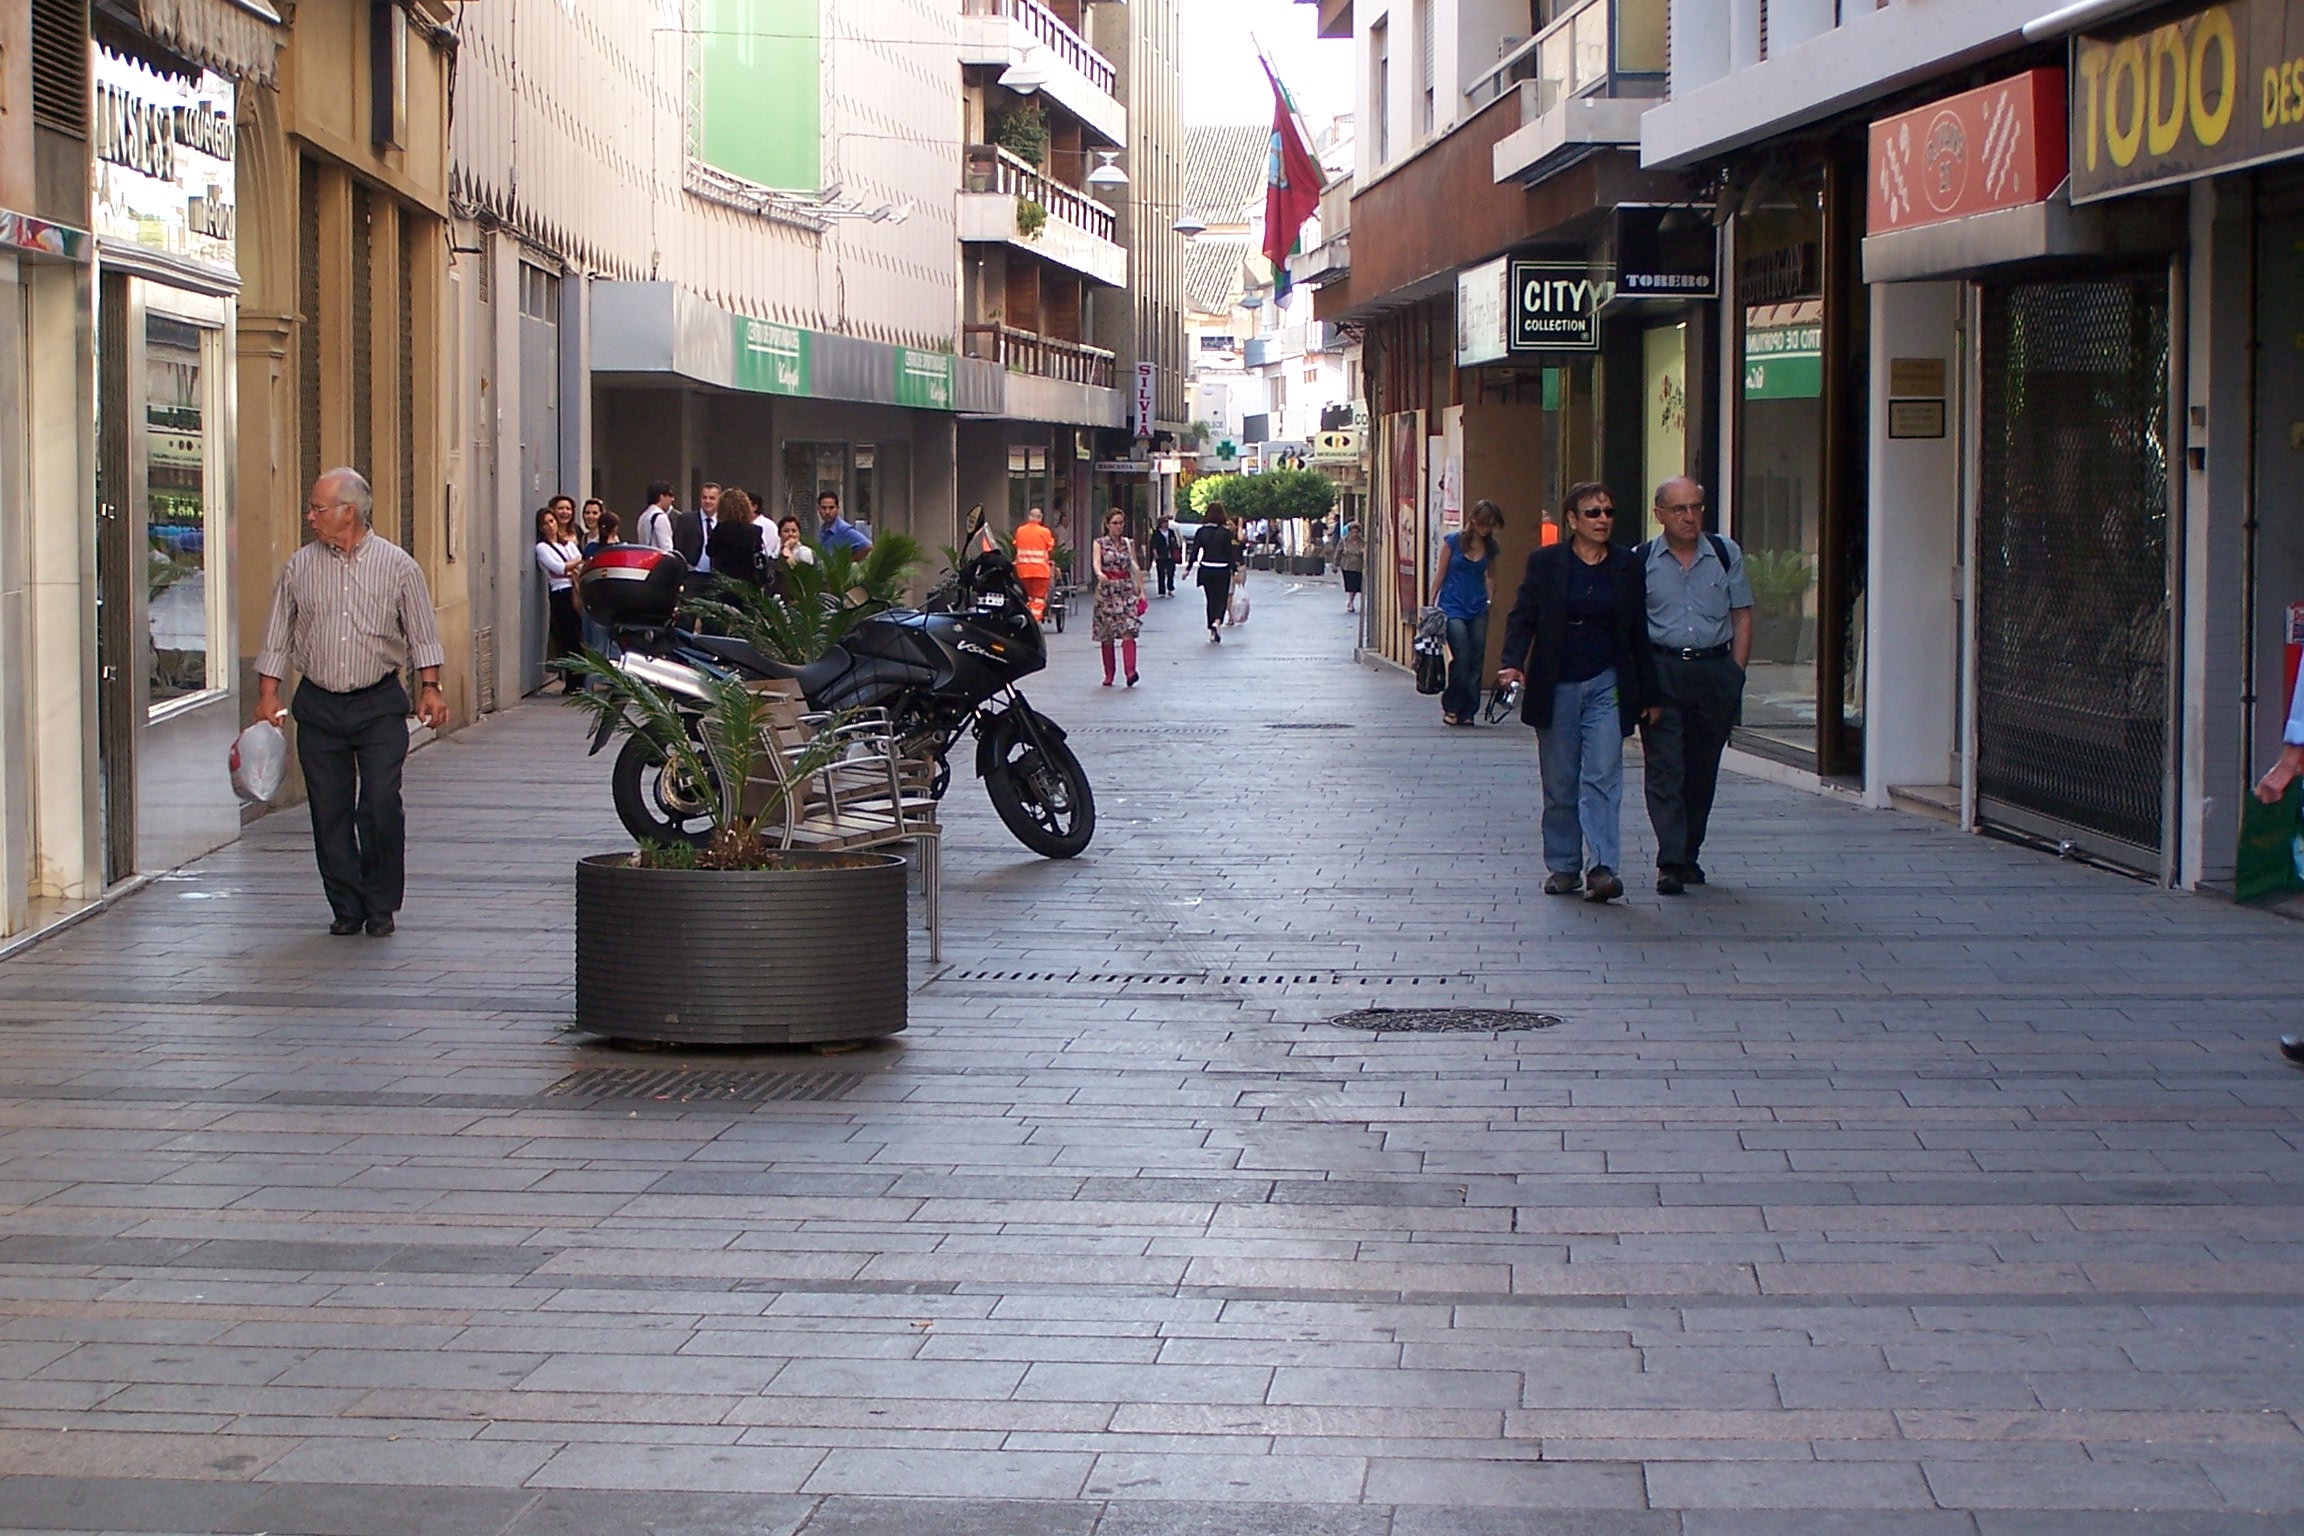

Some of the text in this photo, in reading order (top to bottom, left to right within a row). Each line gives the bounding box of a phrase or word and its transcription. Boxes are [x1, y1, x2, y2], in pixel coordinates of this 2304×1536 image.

[2080, 5, 2236, 173] TODO
[1524, 279, 1588, 312] CITY
[1625, 274, 1710, 288] TORERO
[1524, 318, 1586, 332] COLLECTION
[1138, 365, 1151, 436] SILVIA
